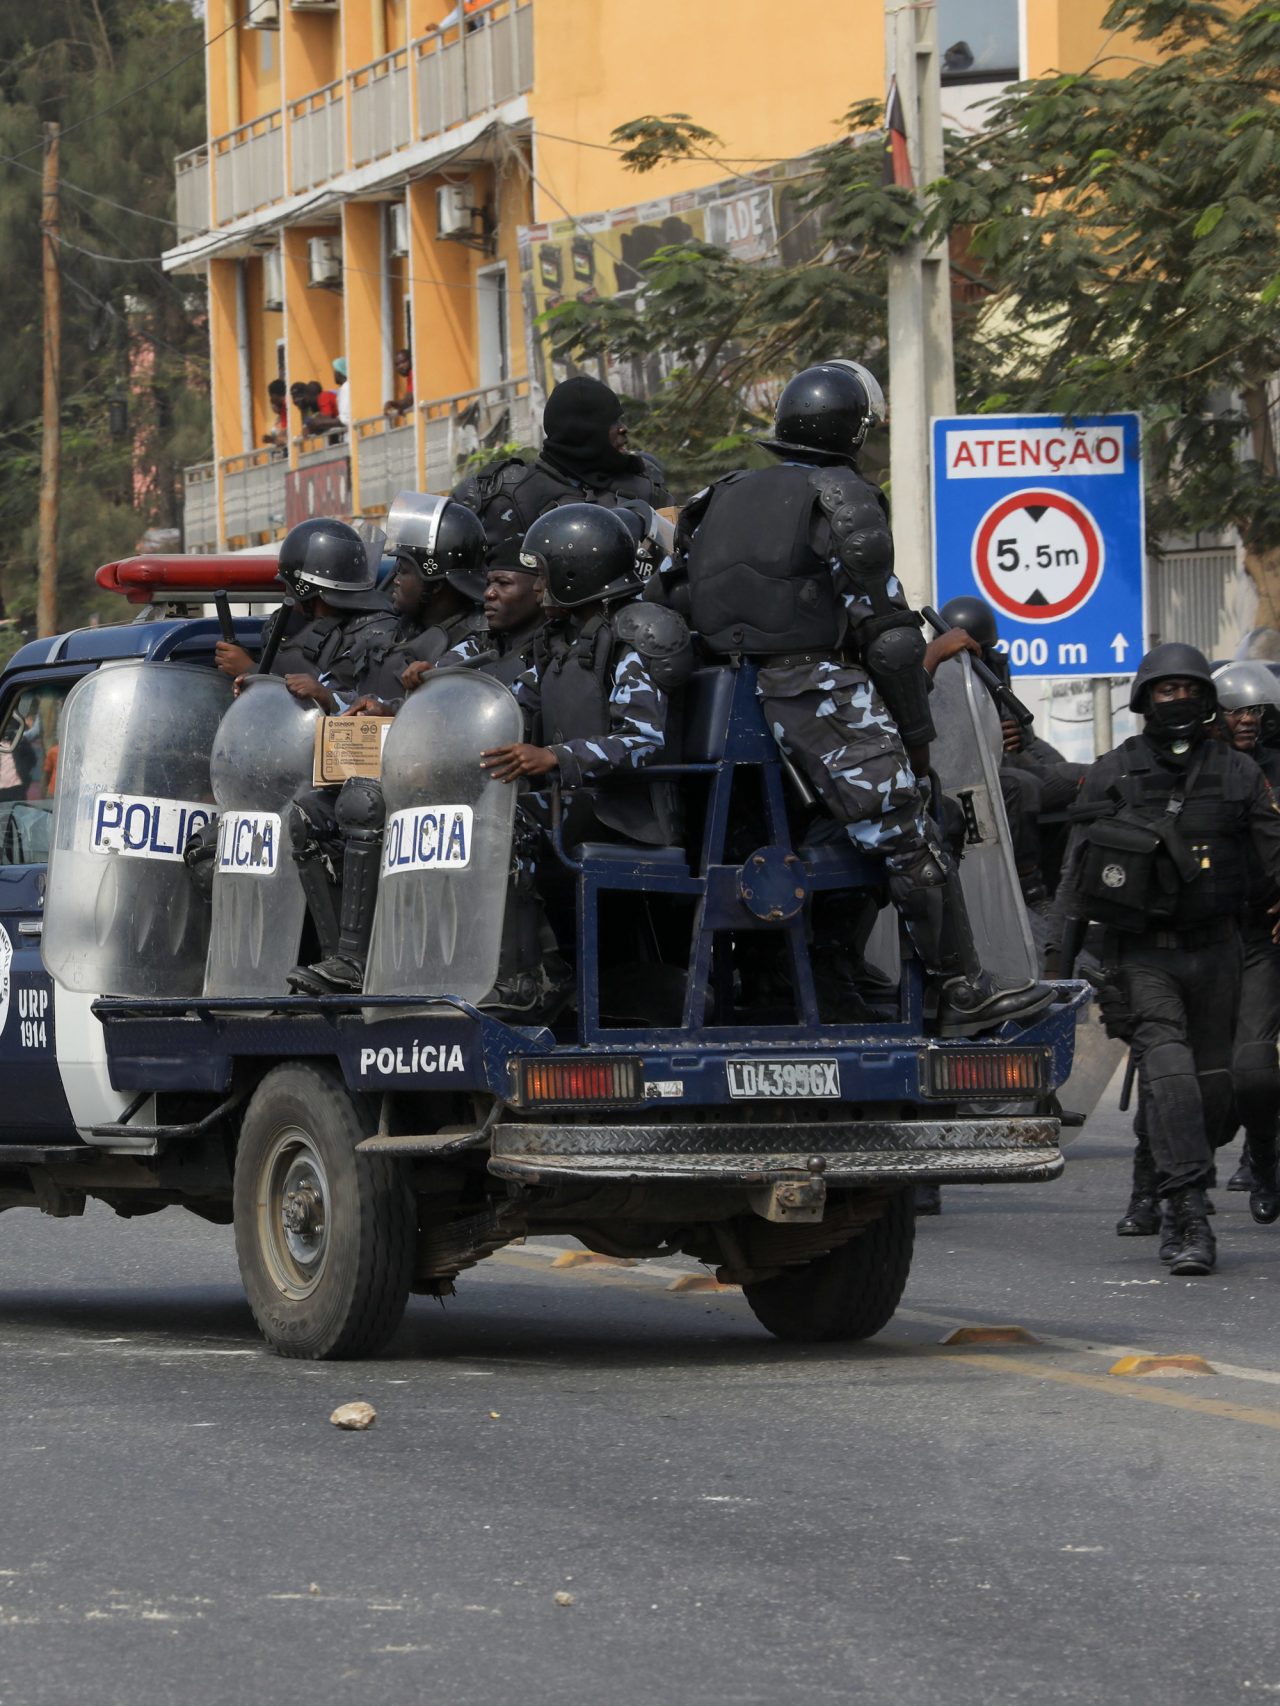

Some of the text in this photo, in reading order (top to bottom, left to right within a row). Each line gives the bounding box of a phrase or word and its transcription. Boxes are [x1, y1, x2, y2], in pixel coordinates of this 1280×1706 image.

[952, 431, 1121, 472] ATENÇÃO
[1058, 641, 1088, 664] m
[95, 800, 217, 855] POLIC
[220, 819, 273, 868] LICIA
[385, 813, 466, 867] OLICIA
[19, 989, 49, 1018] URP
[20, 1021, 47, 1048] 1914
[360, 1039, 465, 1075] POLÍCIA
